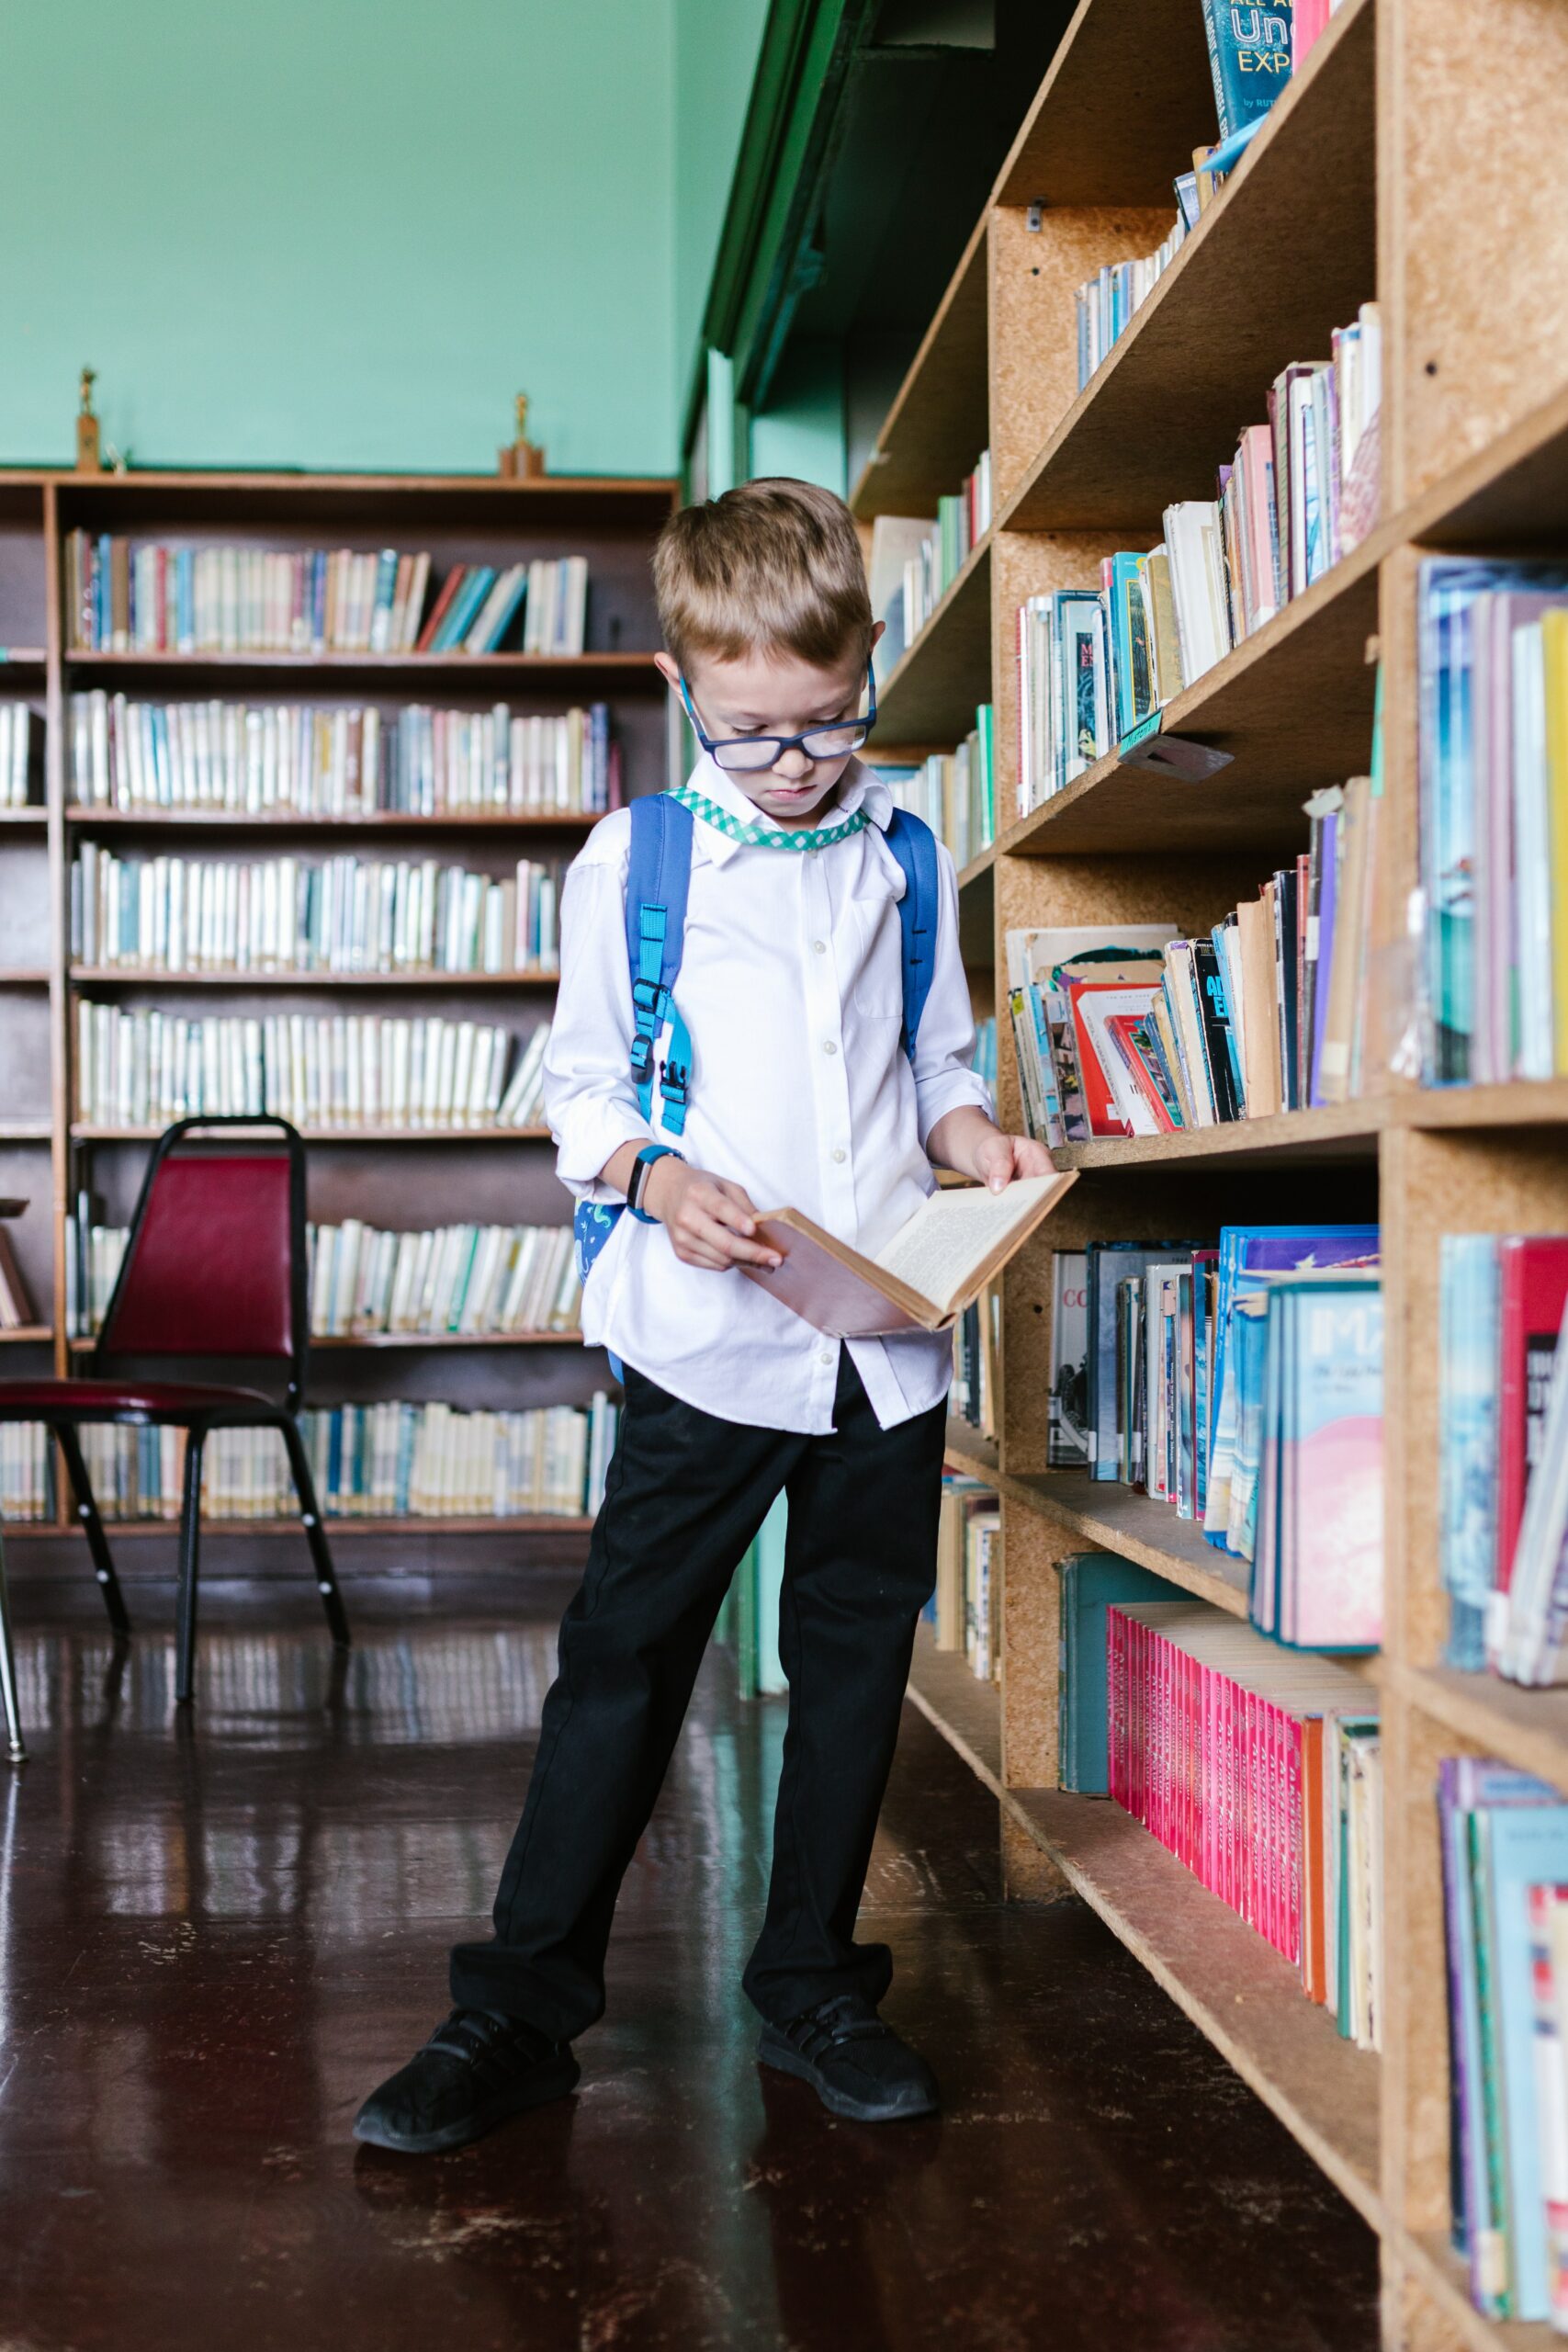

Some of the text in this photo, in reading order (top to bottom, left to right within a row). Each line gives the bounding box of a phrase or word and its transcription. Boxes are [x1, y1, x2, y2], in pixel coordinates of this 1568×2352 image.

[1205, 15, 1217, 55] ABOUT
[1230, 9, 1293, 45] Un
[1243, 97, 1276, 109] by RUT
